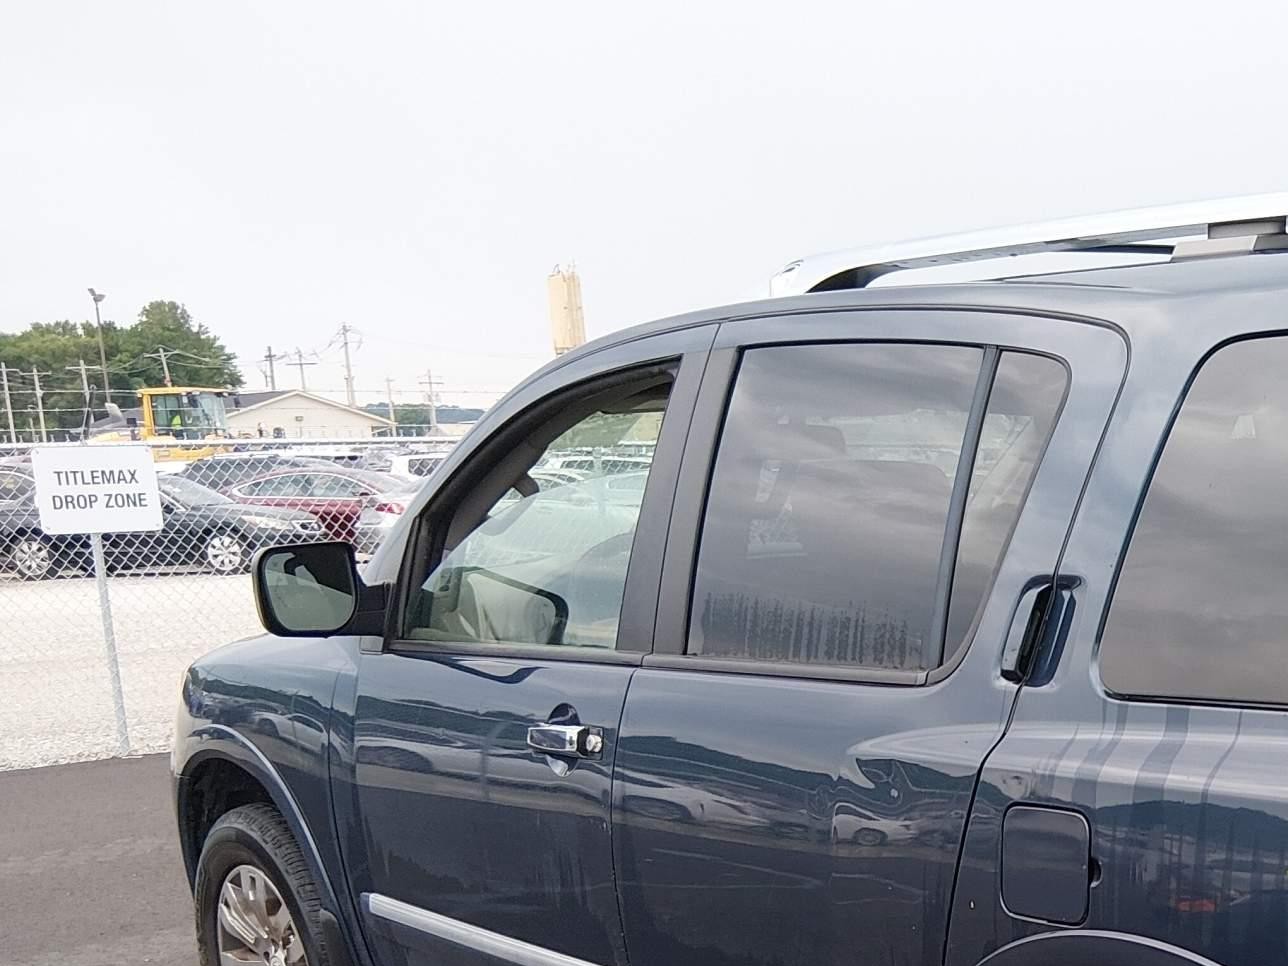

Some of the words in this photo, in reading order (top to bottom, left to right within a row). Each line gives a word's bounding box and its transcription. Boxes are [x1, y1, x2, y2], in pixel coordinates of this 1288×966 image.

[53, 469, 139, 486] TITLEMAX
[52, 494, 98, 511] DROP
[104, 492, 148, 509] ZONE
